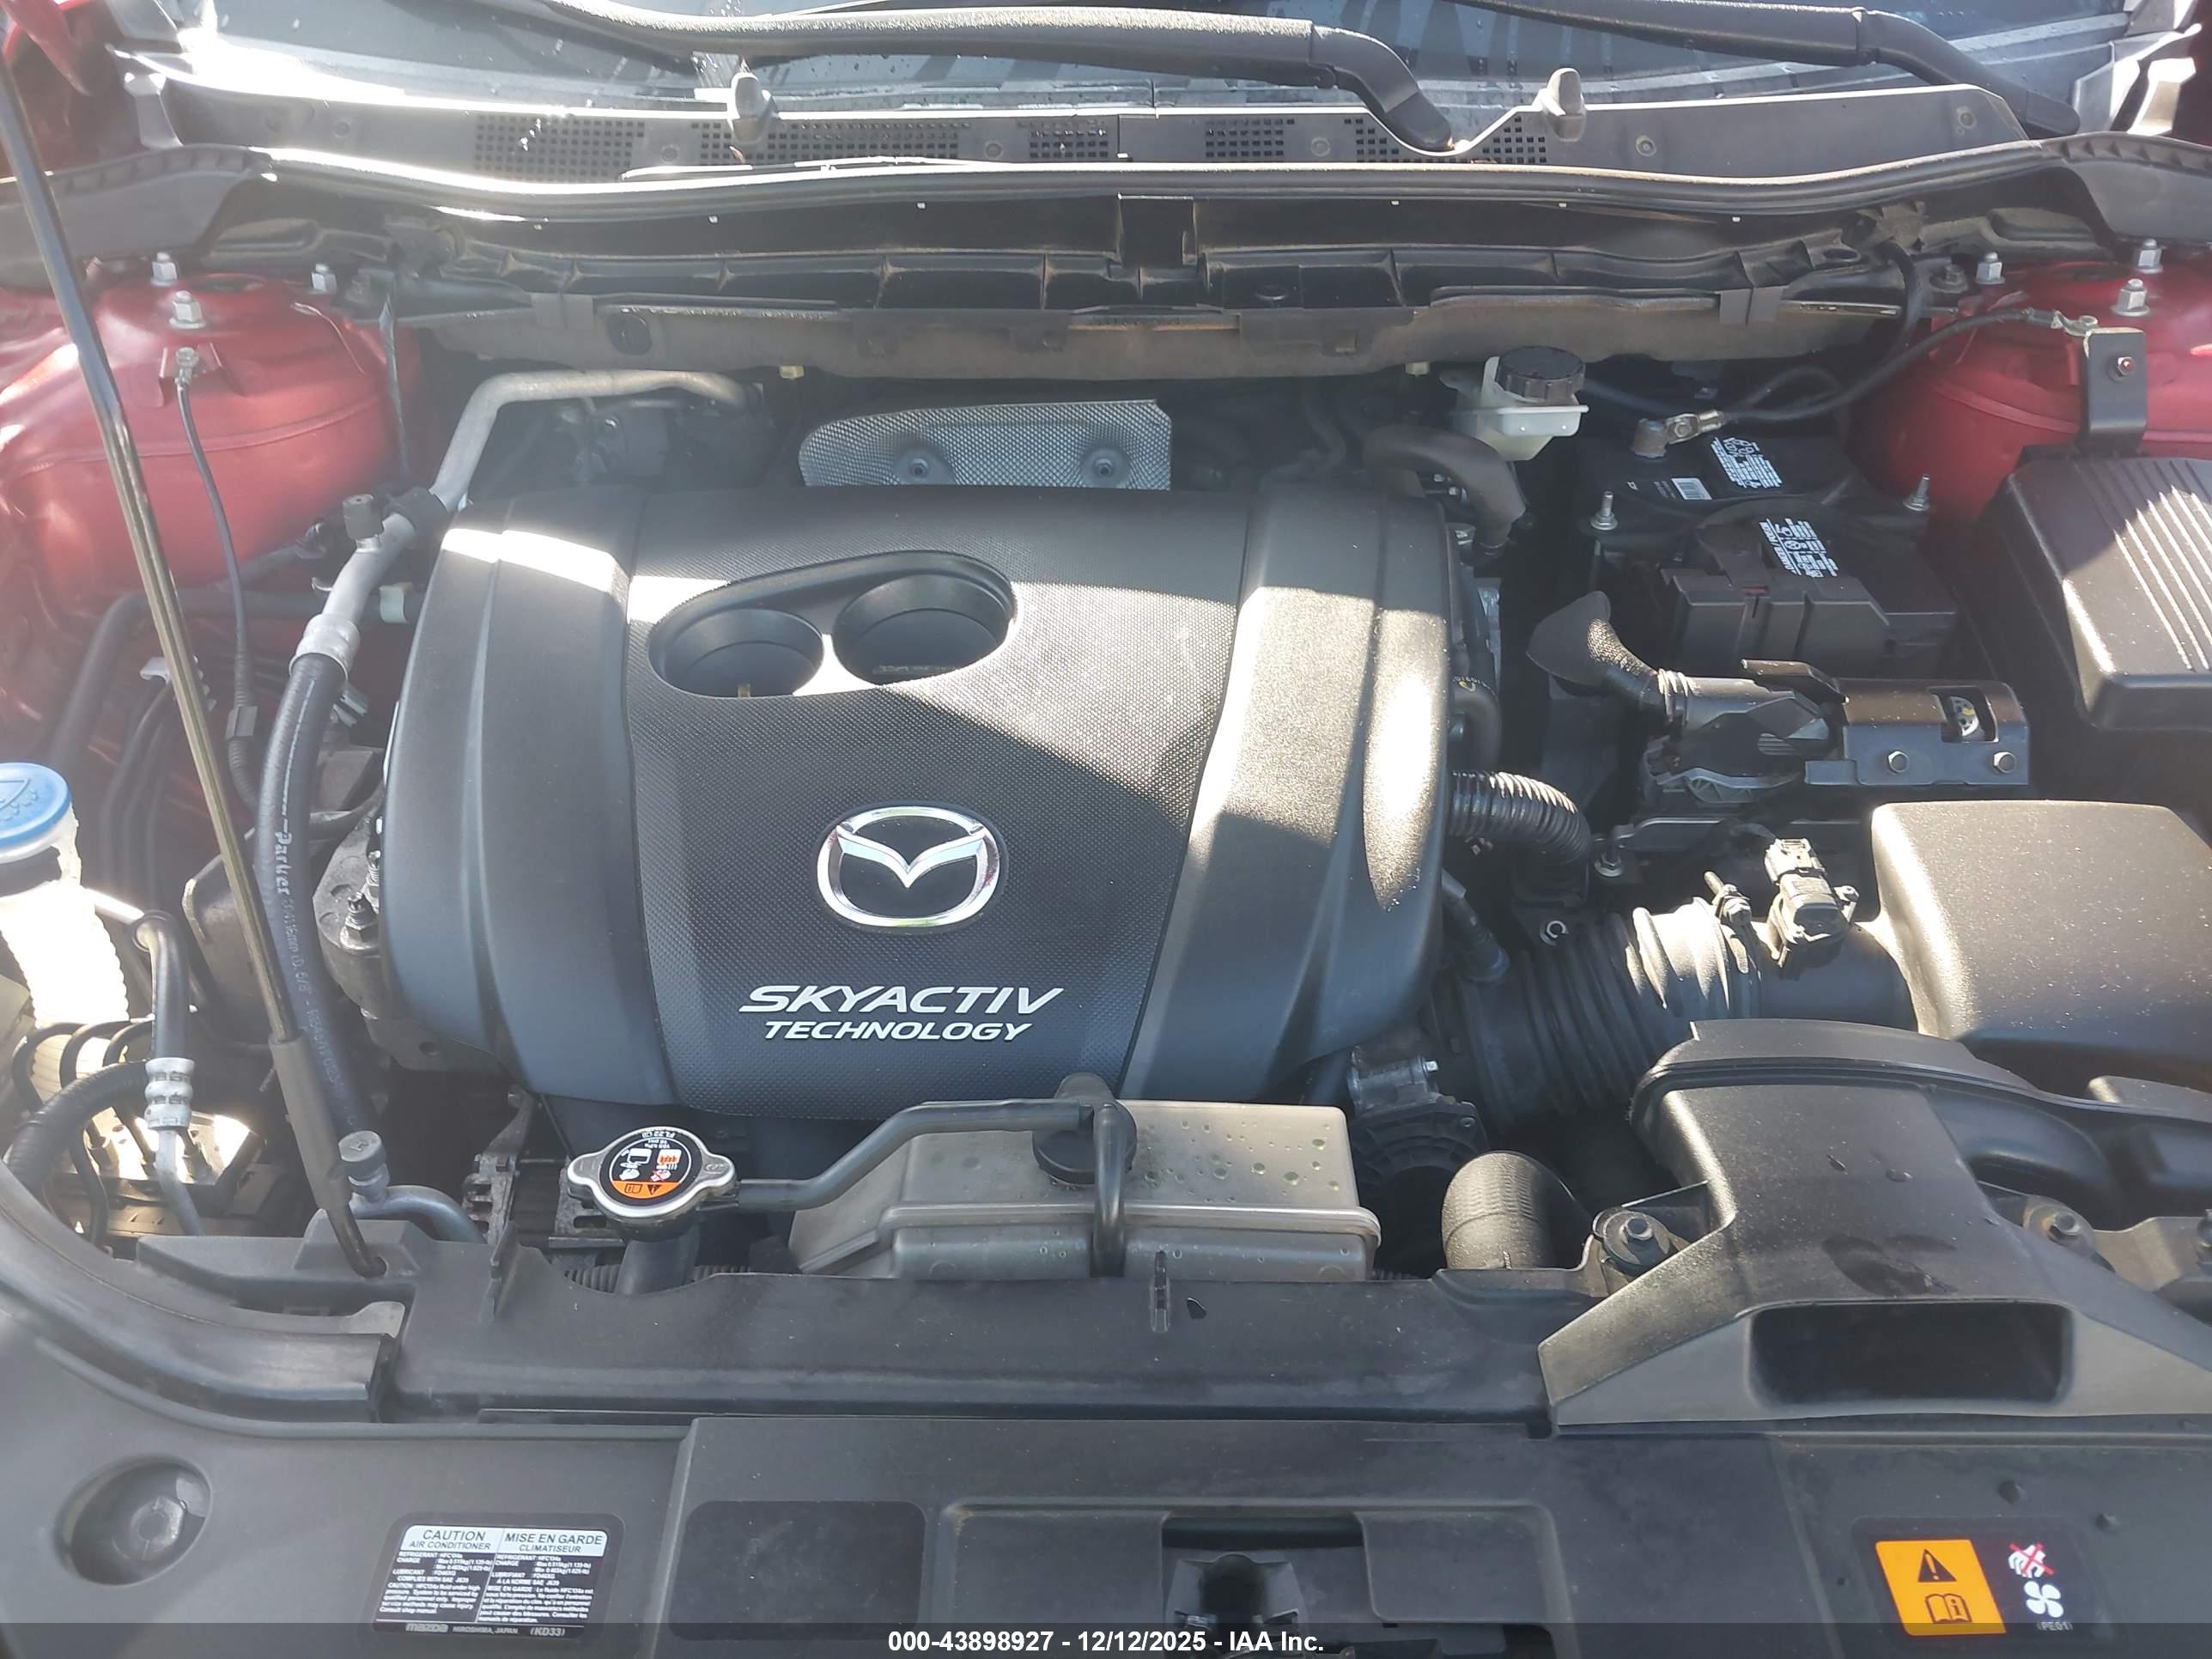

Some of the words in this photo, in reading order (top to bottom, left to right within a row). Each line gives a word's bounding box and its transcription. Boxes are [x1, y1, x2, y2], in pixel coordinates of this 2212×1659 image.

[275, 831, 292, 895] Parker
[738, 986, 1064, 1014] SKYACTIV
[765, 1021, 1032, 1042] TECHNOLOGY
[423, 1529, 486, 1541] CAUTION
[505, 1533, 535, 1542] MISE
[538, 1534, 555, 1543] EN
[558, 1534, 603, 1545] GARDE
[427, 1541, 490, 1550] CONDITIONER
[519, 1544, 581, 1553] CLIMATISEUR
[406, 1623, 448, 1633] mazda
[530, 1627, 566, 1637] (KD33)
